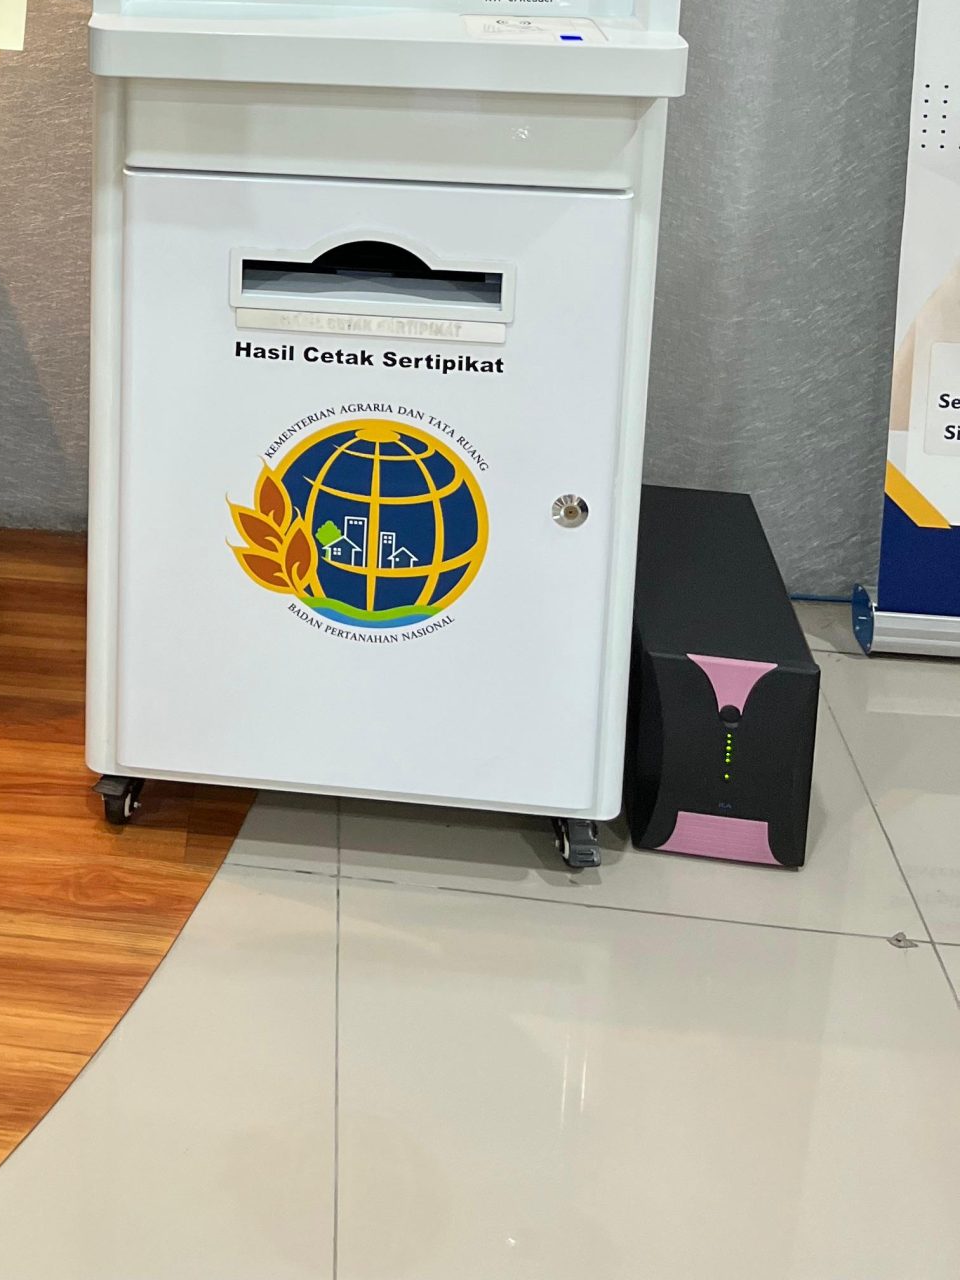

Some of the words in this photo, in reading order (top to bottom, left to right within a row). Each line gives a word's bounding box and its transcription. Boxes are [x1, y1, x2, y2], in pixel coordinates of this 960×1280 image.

[235, 341, 294, 361] Hasil
[303, 347, 374, 366] Cetak
[382, 351, 504, 374] Sertipikat
[939, 393, 960, 409] Se
[264, 407, 336, 459] KEMENTERIAN
[340, 403, 393, 413] AGRARIA
[398, 406, 425, 421] DAN
[428, 415, 454, 438] TATA
[456, 436, 489, 472] RUANG
[287, 602, 322, 630] BADAN
[324, 624, 399, 643] PERTANAHAN
[402, 615, 456, 641] NASIONAL
